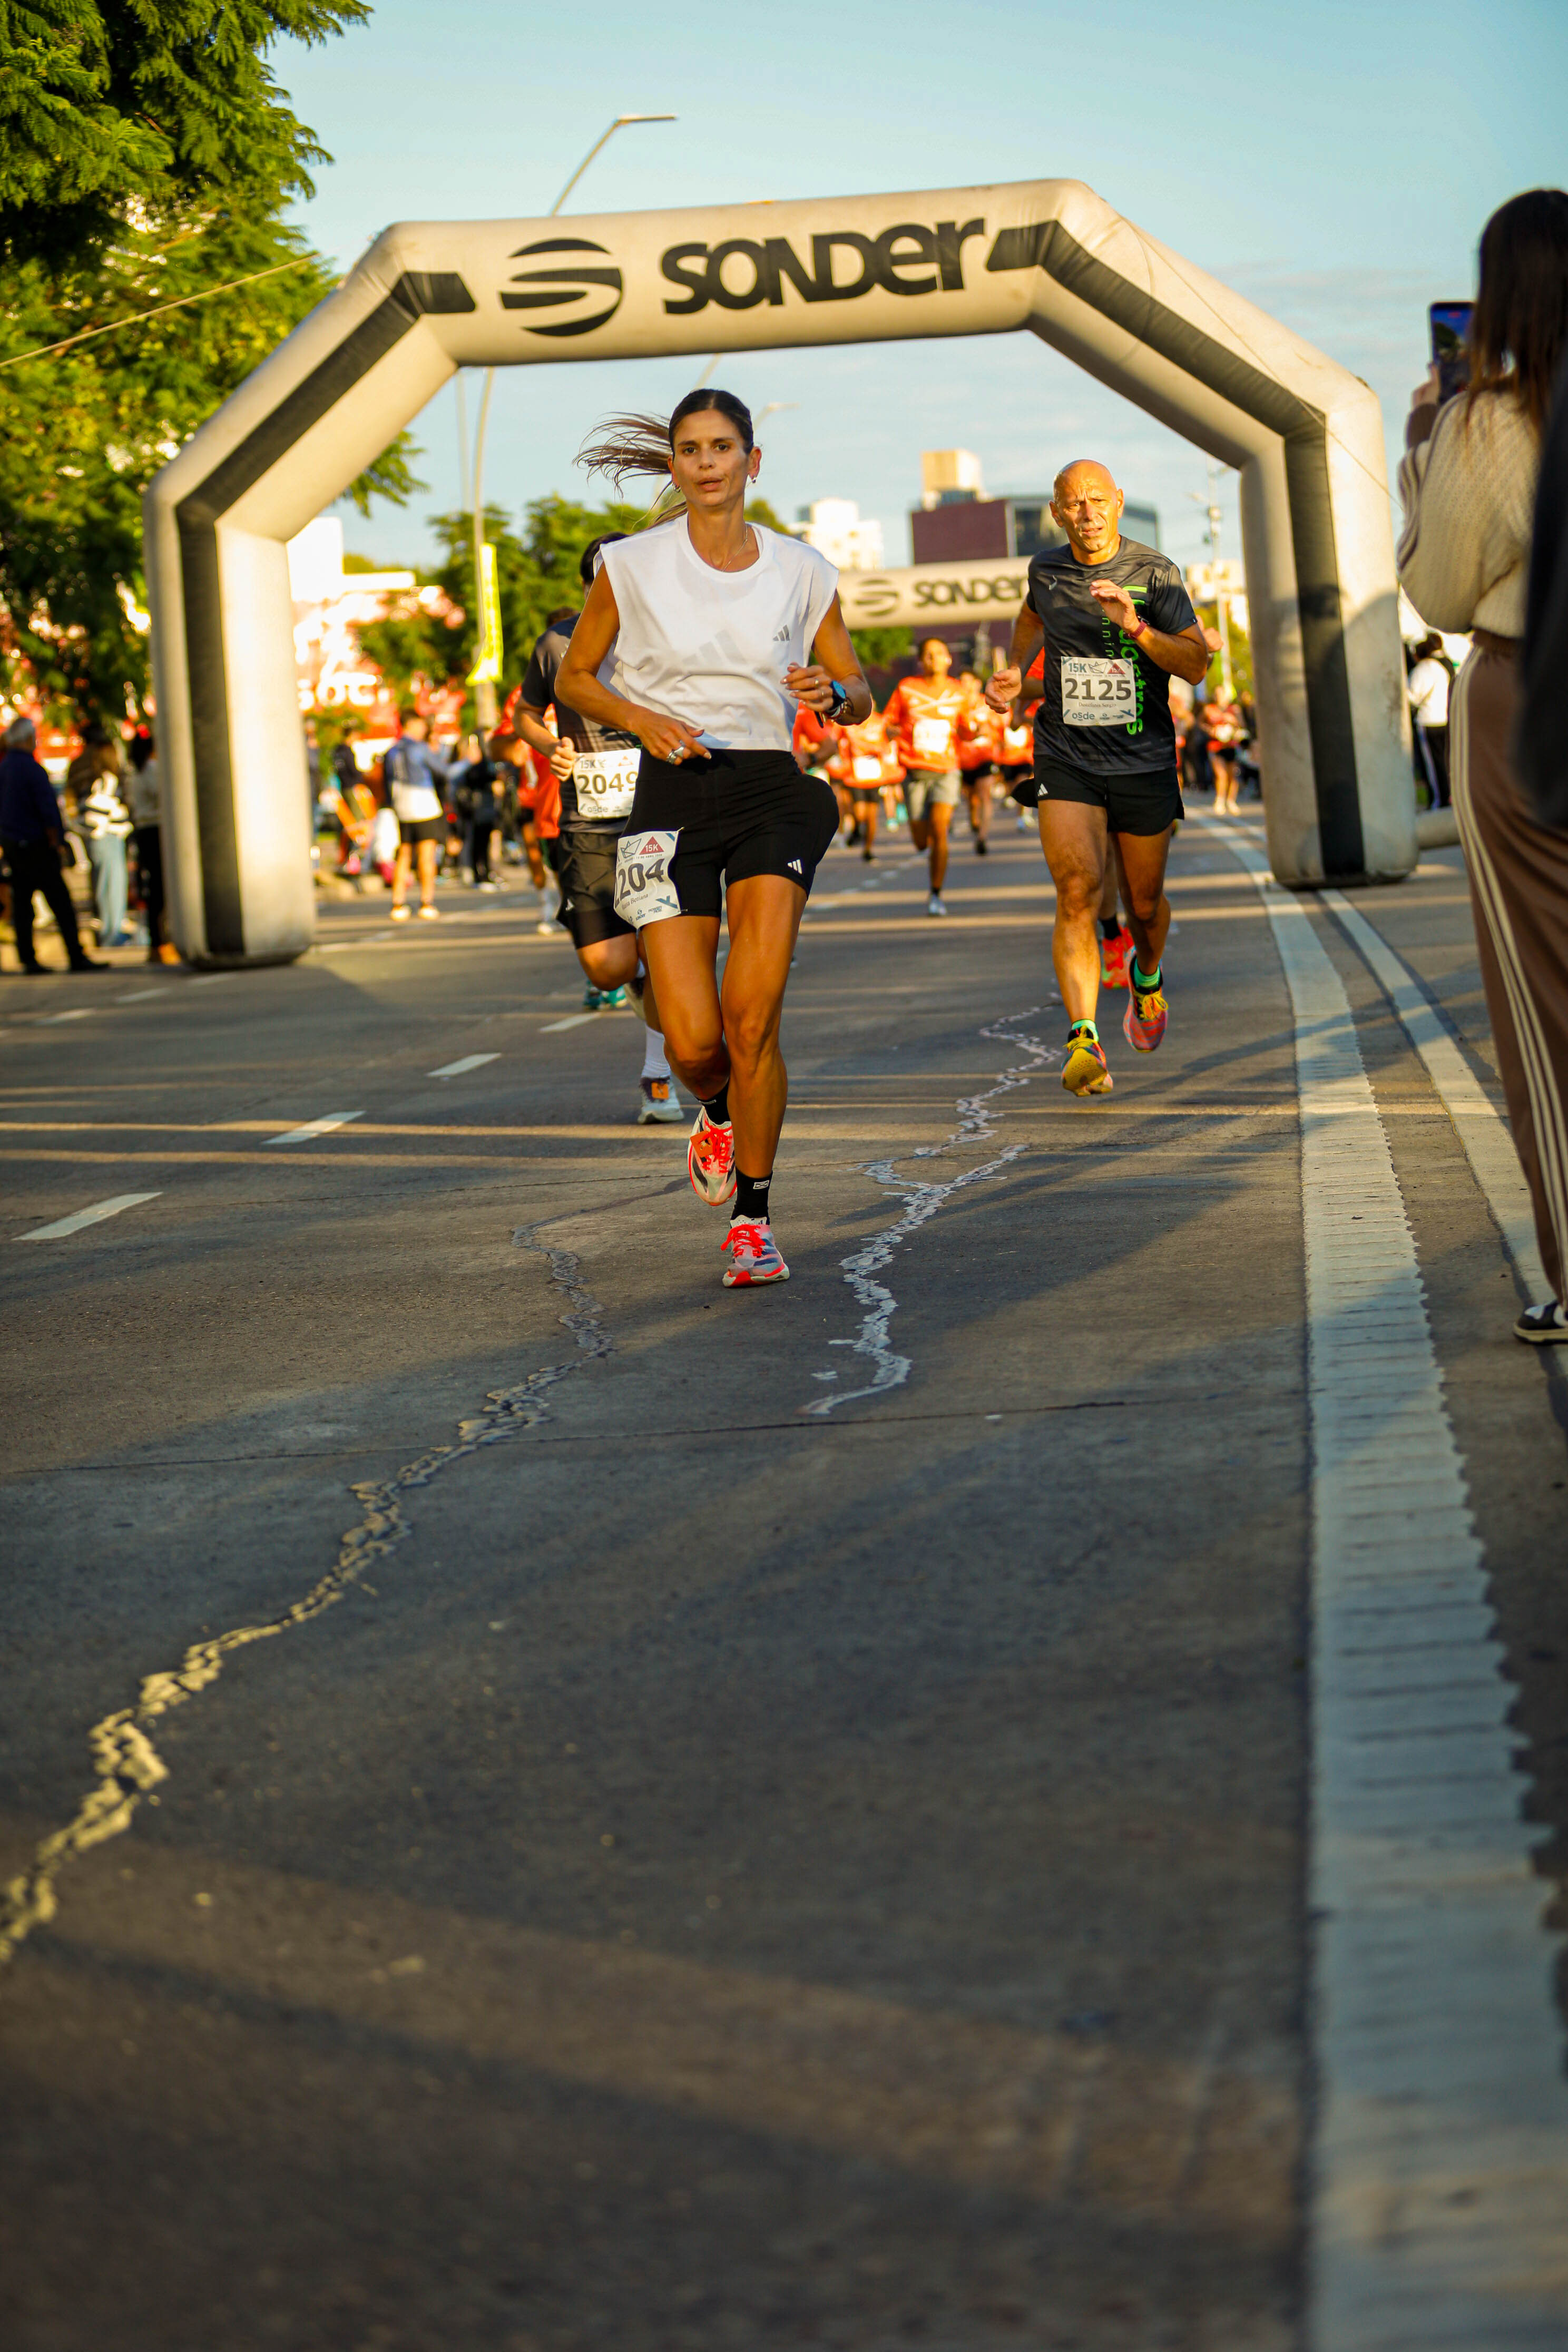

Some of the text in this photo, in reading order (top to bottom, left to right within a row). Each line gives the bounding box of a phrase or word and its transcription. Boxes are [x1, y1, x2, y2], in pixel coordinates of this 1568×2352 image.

[1068, 662, 1087, 673] 15K
[1065, 678, 1131, 700] 2125
[581, 759, 596, 769] 15K
[577, 771, 639, 794] 2049
[645, 844, 658, 852] 15K
